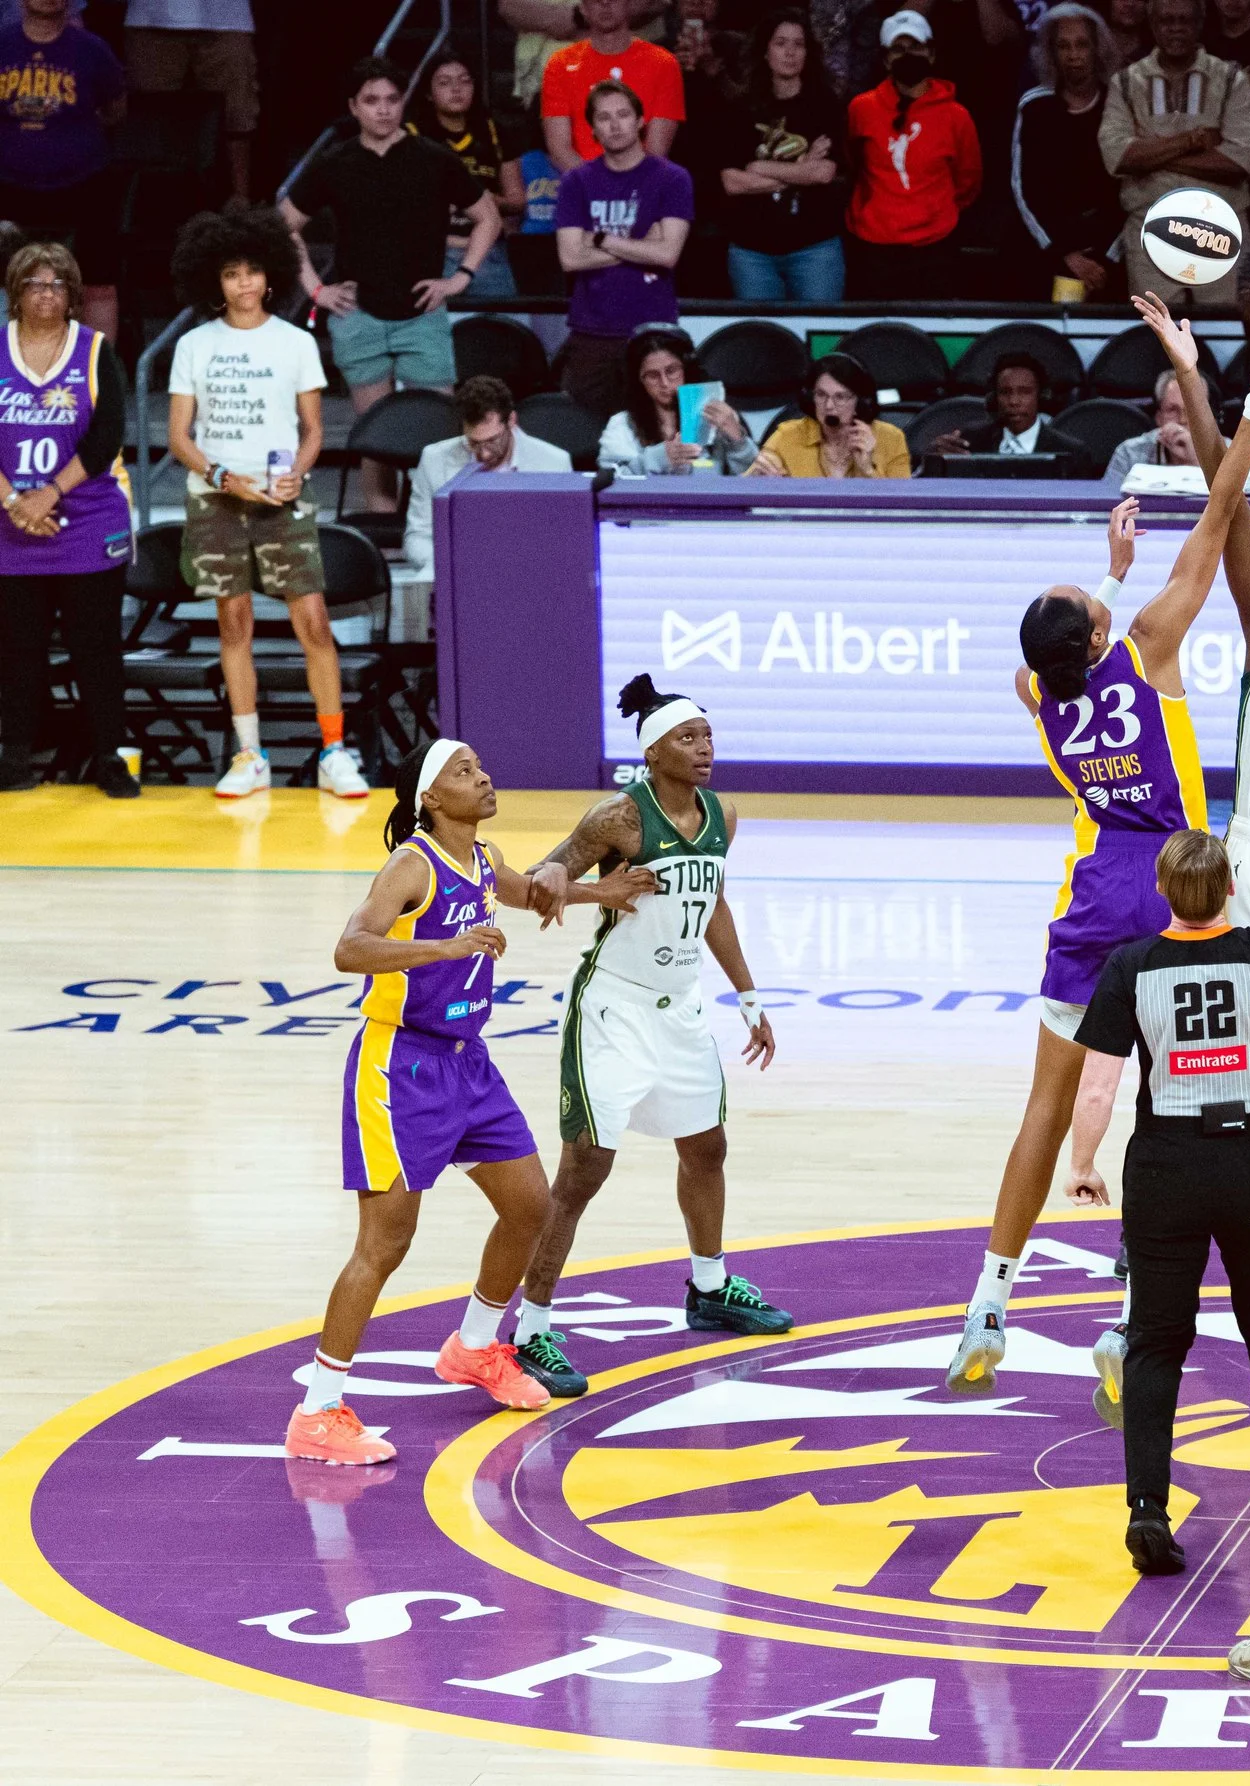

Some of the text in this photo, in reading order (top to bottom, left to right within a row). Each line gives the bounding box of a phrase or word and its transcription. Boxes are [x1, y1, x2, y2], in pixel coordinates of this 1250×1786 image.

[1168, 220, 1231, 255] Wilson
[15, 437, 60, 475] 10
[758, 611, 971, 675] Albert
[1058, 683, 1142, 756] 23
[1079, 753, 1142, 783] STEVENS
[1112, 783, 1153, 803] AT&T
[680, 900, 707, 939] 17
[464, 951, 485, 990] 7
[448, 998, 489, 1016] UCLA Health
[1173, 980, 1237, 1042] 22
[1176, 1053, 1241, 1070] Emirates
